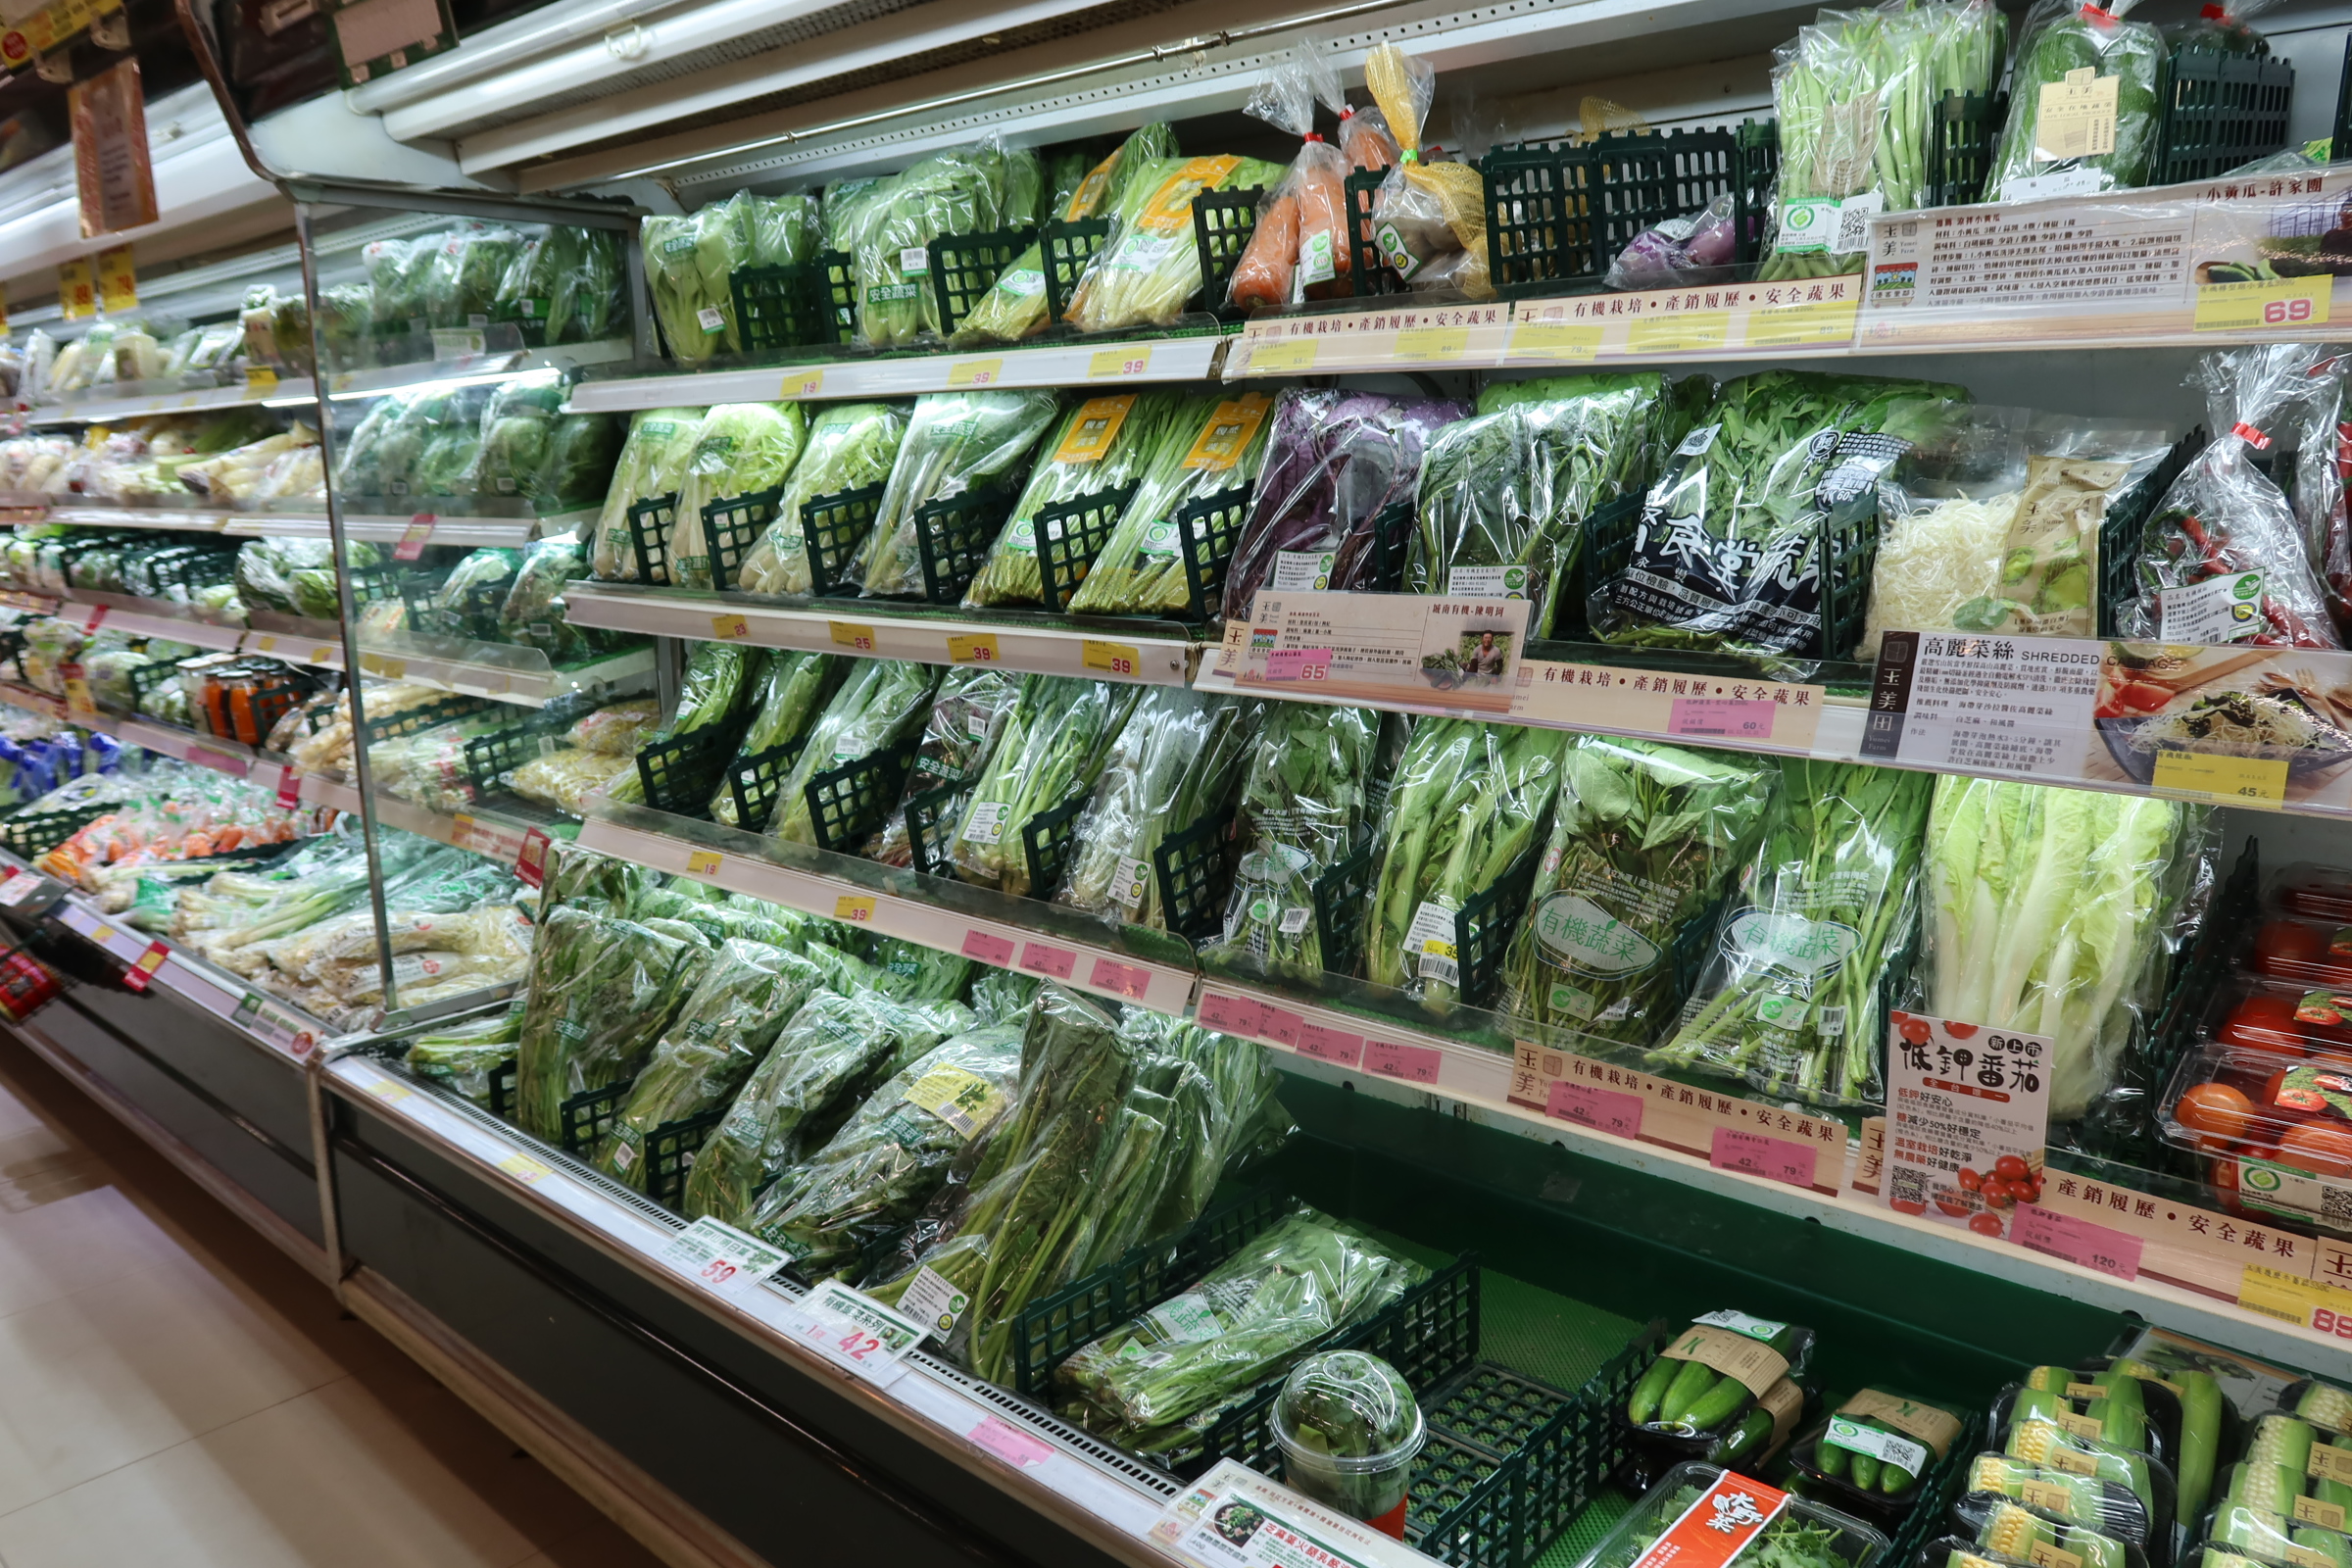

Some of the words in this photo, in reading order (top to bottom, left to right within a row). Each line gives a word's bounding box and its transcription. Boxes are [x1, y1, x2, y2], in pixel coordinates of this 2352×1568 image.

[869, 284, 917, 303] 安全蔬菜
[1574, 298, 1642, 318] 有機栽培
[1664, 291, 1740, 311] 產銷履歷
[1765, 283, 1846, 305] 安全蔬果
[1289, 318, 1343, 336] 有機栽培
[1358, 313, 1418, 331] 產銷履歷
[1435, 309, 1497, 328] 安全蔬果
[2265, 299, 2311, 323] 69
[972, 370, 990, 383] 39
[1122, 360, 1144, 374] 39
[855, 637, 871, 650] 25
[972, 647, 991, 662] 39
[1220, 627, 1245, 667] 玉美
[1924, 637, 2015, 661] 高麗菜絲
[2021, 651, 2100, 665] SHREDDED
[1110, 658, 1132, 673] 39
[1301, 664, 1326, 680] 65
[1543, 666, 1612, 688] 有機栽培
[1633, 675, 1708, 696] 產銷履歷
[1731, 685, 1811, 707] 安全蔬果
[1916, 698, 1949, 708] 推薦料理
[917, 758, 963, 781] 安全蔬菜
[851, 908, 867, 921] 39
[1542, 906, 1638, 963] 有機蔬菜
[1742, 920, 1842, 959] 有機蔬菜
[1445, 946, 1459, 959] 35
[1988, 1035, 2042, 1057] 新上市
[1898, 1037, 2040, 1094] 低鉀番茄
[1515, 1048, 1539, 1096] 玉美
[1572, 1060, 1639, 1090] 有機栽培
[1660, 1084, 1735, 1116] 產銷履歷
[1755, 1108, 1834, 1142] 安全蔬果
[1897, 1087, 1953, 1107] 低鉀好安心
[1893, 1149, 1960, 1174] 無農藥好健康
[1894, 1137, 1972, 1163] 溫室栽培好乾淨
[2057, 1177, 2156, 1220] 產銷履歷
[2188, 1213, 2295, 1258] 安全蔬果
[701, 1258, 737, 1284] 59
[2313, 1307, 2352, 1340] 89
[837, 1330, 880, 1361] 42
